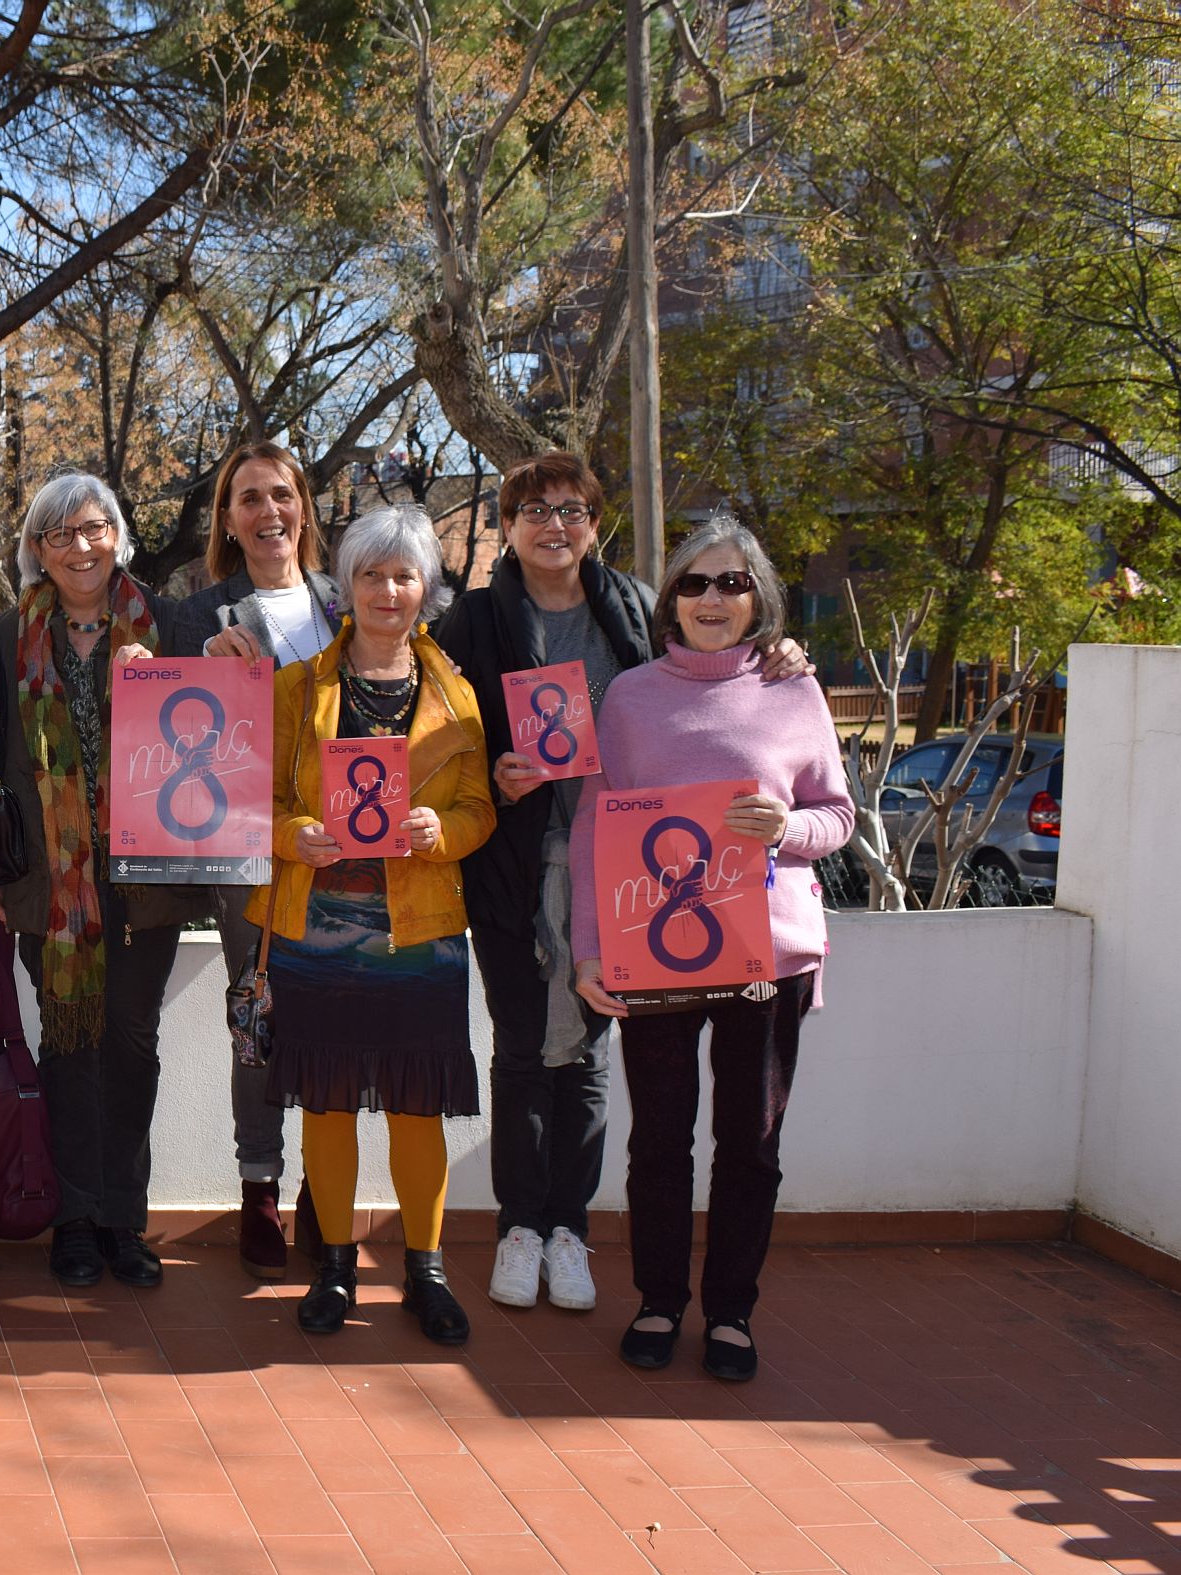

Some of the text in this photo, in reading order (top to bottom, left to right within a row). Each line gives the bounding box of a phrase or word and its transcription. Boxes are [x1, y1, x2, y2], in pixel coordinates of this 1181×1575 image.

[123, 668, 182, 681] Dones
[329, 746, 364, 754] Dones
[518, 694, 585, 741] març
[531, 682, 578, 766] 8
[129, 719, 253, 784] març
[156, 686, 228, 842] 8
[330, 772, 403, 813] març
[346, 755, 390, 844] 8
[606, 799, 664, 812] Dones
[614, 846, 744, 918] març
[641, 815, 724, 973] 8
